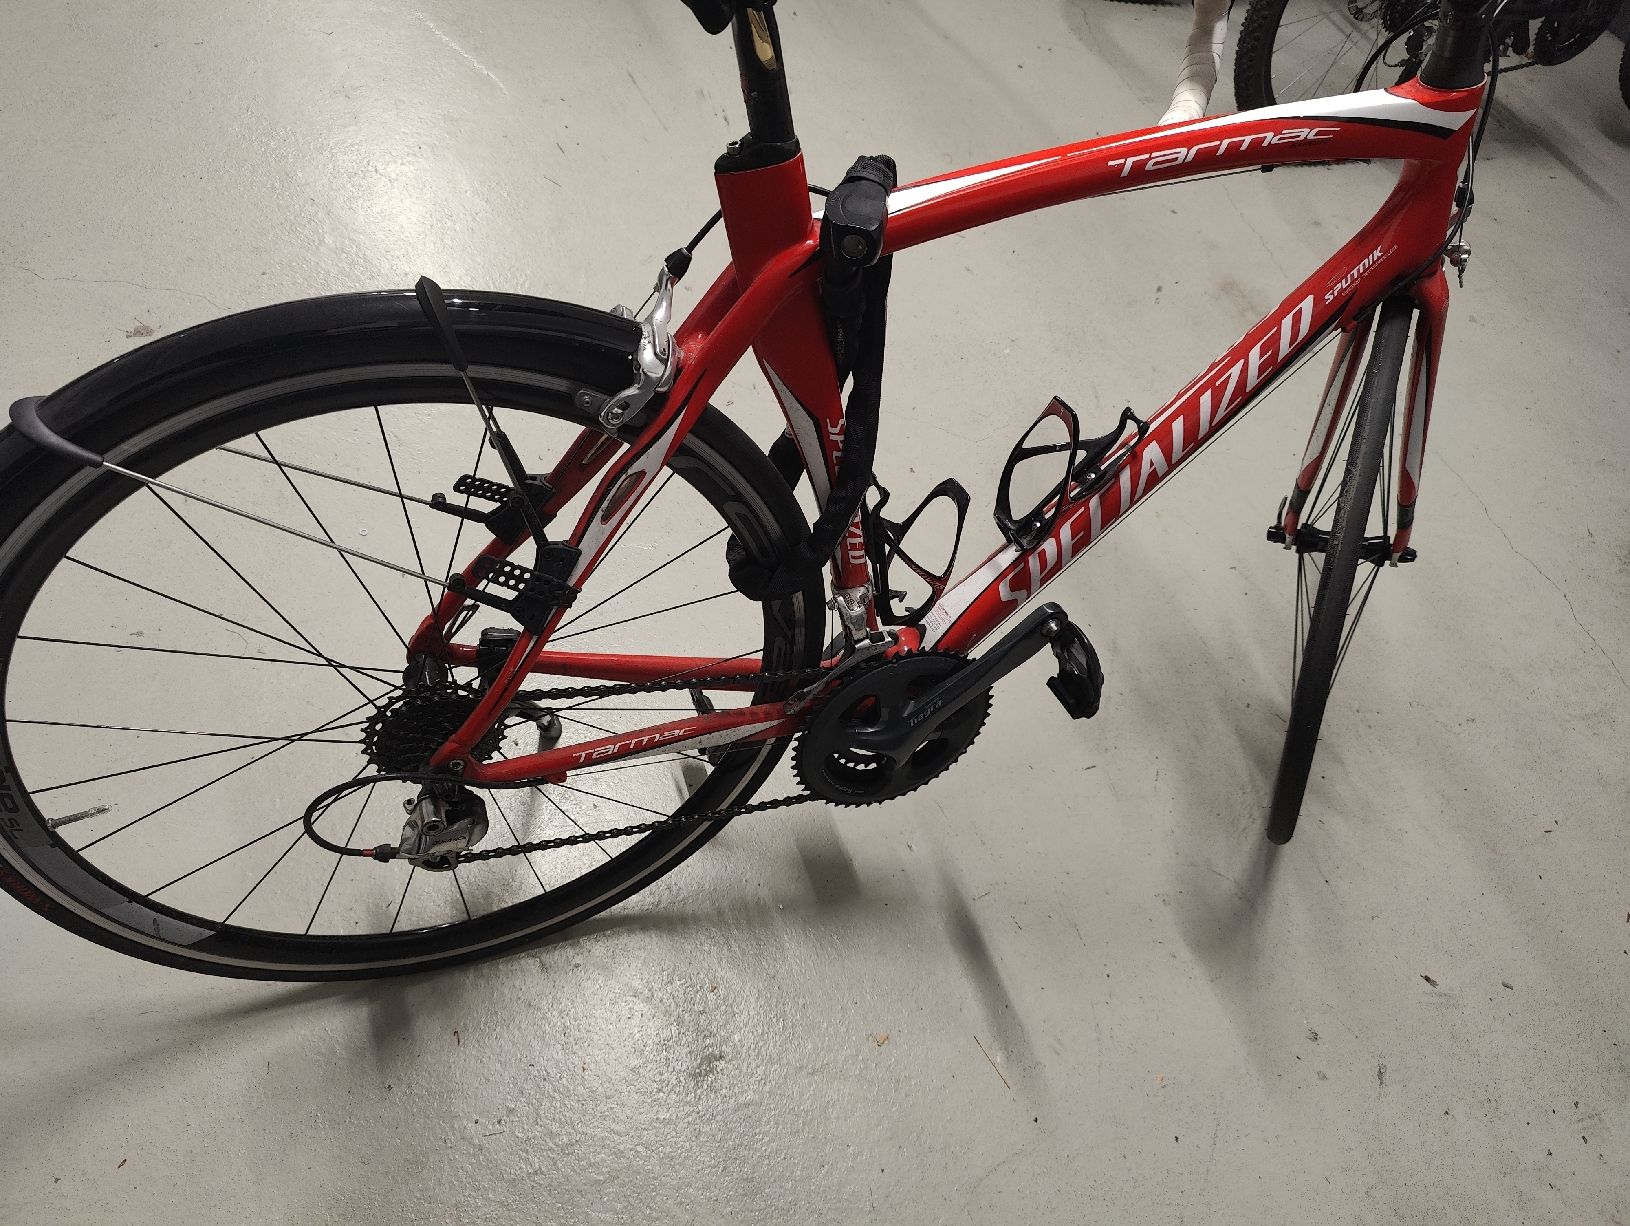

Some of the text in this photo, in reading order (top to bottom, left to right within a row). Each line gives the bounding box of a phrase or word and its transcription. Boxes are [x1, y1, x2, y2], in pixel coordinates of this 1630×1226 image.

[1107, 127, 1341, 178] Tarmac
[999, 295, 1314, 606] SPECIALIZED
[573, 727, 697, 762] Tarmac
